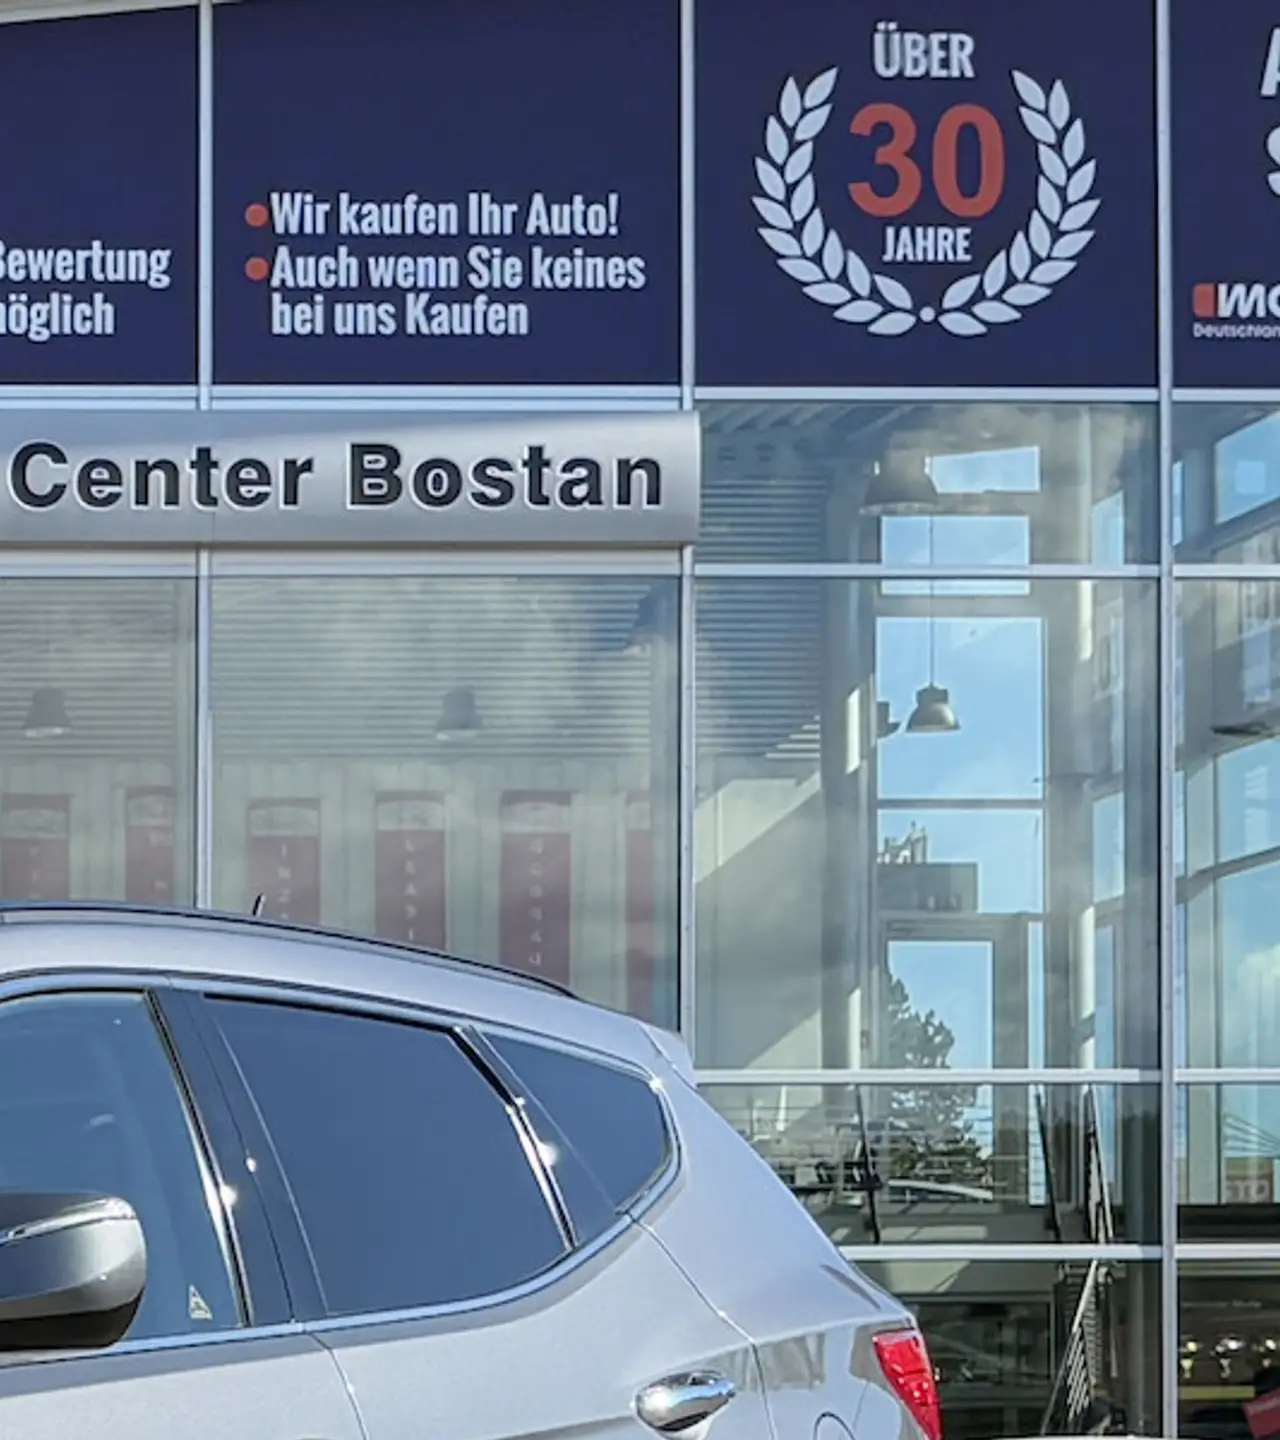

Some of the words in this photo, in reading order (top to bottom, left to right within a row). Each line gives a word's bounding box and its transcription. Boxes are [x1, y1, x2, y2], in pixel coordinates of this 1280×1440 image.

[873, 20, 976, 79] ÜBER
[847, 102, 1006, 218] 30
[270, 192, 331, 235] Wir
[339, 192, 459, 236] kaufen
[467, 192, 519, 236] Ihr
[525, 192, 620, 236] Auto!
[269, 244, 359, 289] Auch
[367, 254, 459, 289] wenn
[467, 245, 524, 289] Sie
[530, 245, 647, 289] keines
[881, 226, 973, 263] JAHRE
[270, 292, 324, 336] bei
[333, 301, 397, 336] uns
[405, 292, 530, 336] Kaufen
[8, 439, 316, 510] Center
[346, 439, 666, 510] Bostan
